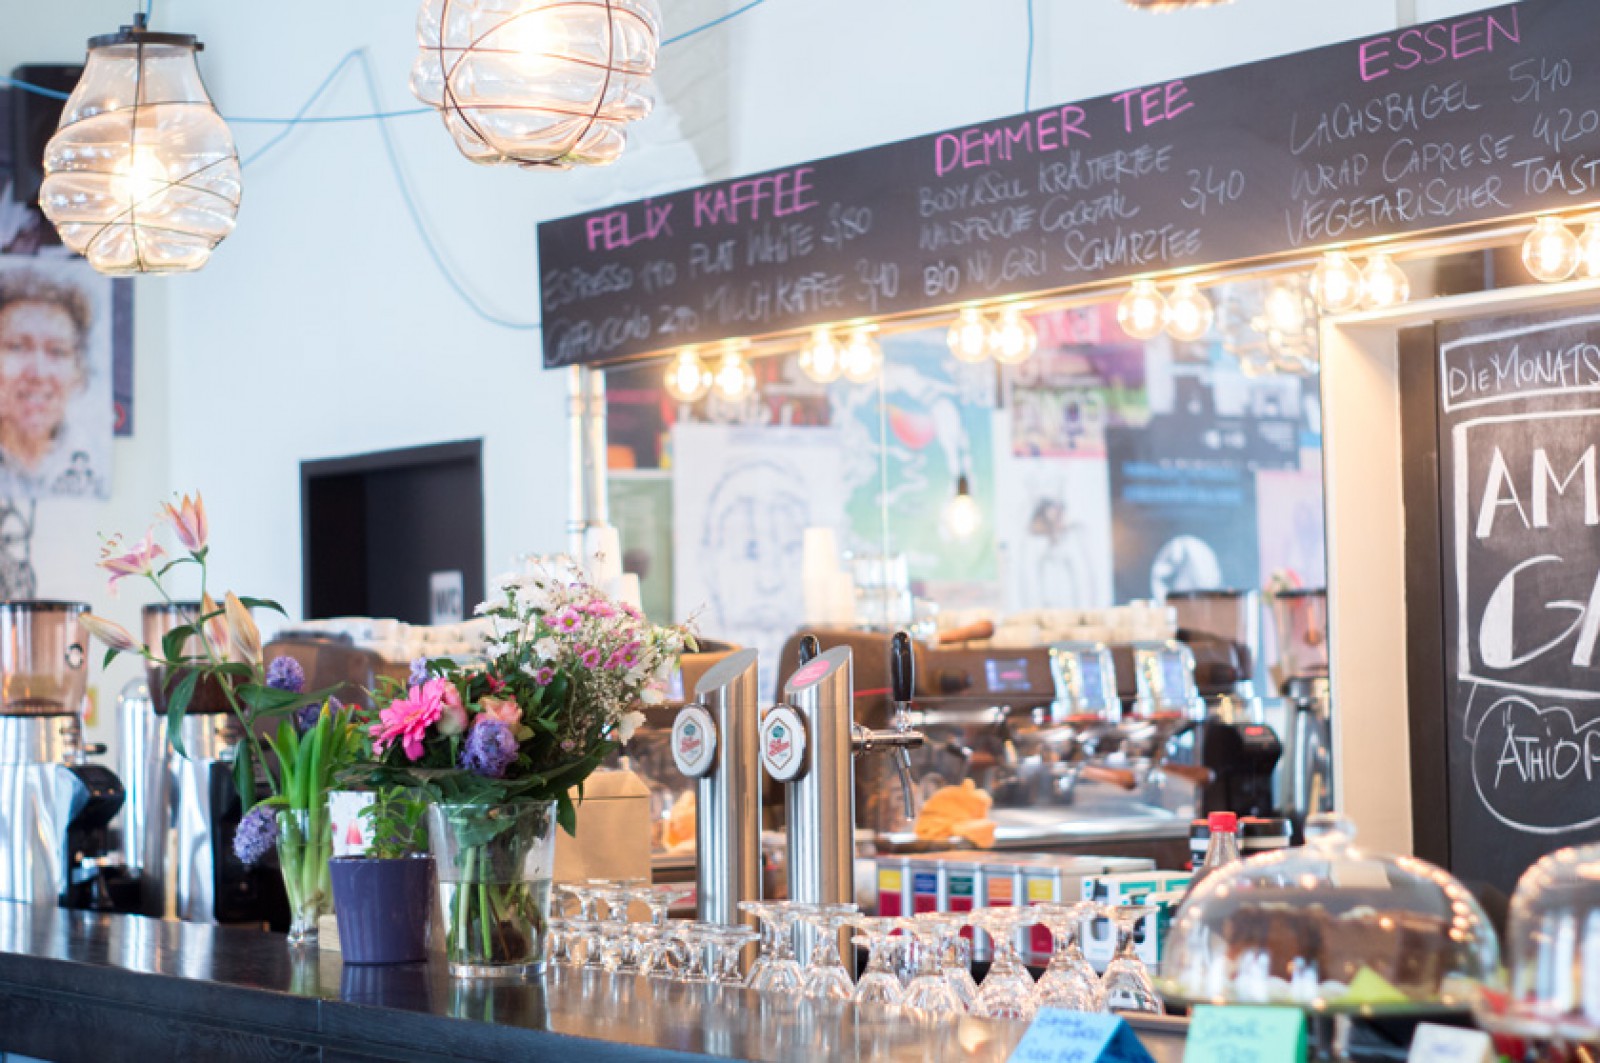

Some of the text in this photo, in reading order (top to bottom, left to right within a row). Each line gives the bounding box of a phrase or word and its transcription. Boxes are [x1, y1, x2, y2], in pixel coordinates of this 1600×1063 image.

[1359, 4, 1521, 83] ESSEN
[934, 79, 1195, 178] DEMMER TEE
[1289, 56, 1572, 155] LACHSBAGEL 5,40
[1180, 164, 1246, 216] 3,40
[1290, 107, 1600, 201] WRAP CAPRESE 4,20
[1511, 153, 1600, 197] TOAST
[693, 167, 819, 228] KAFFEE
